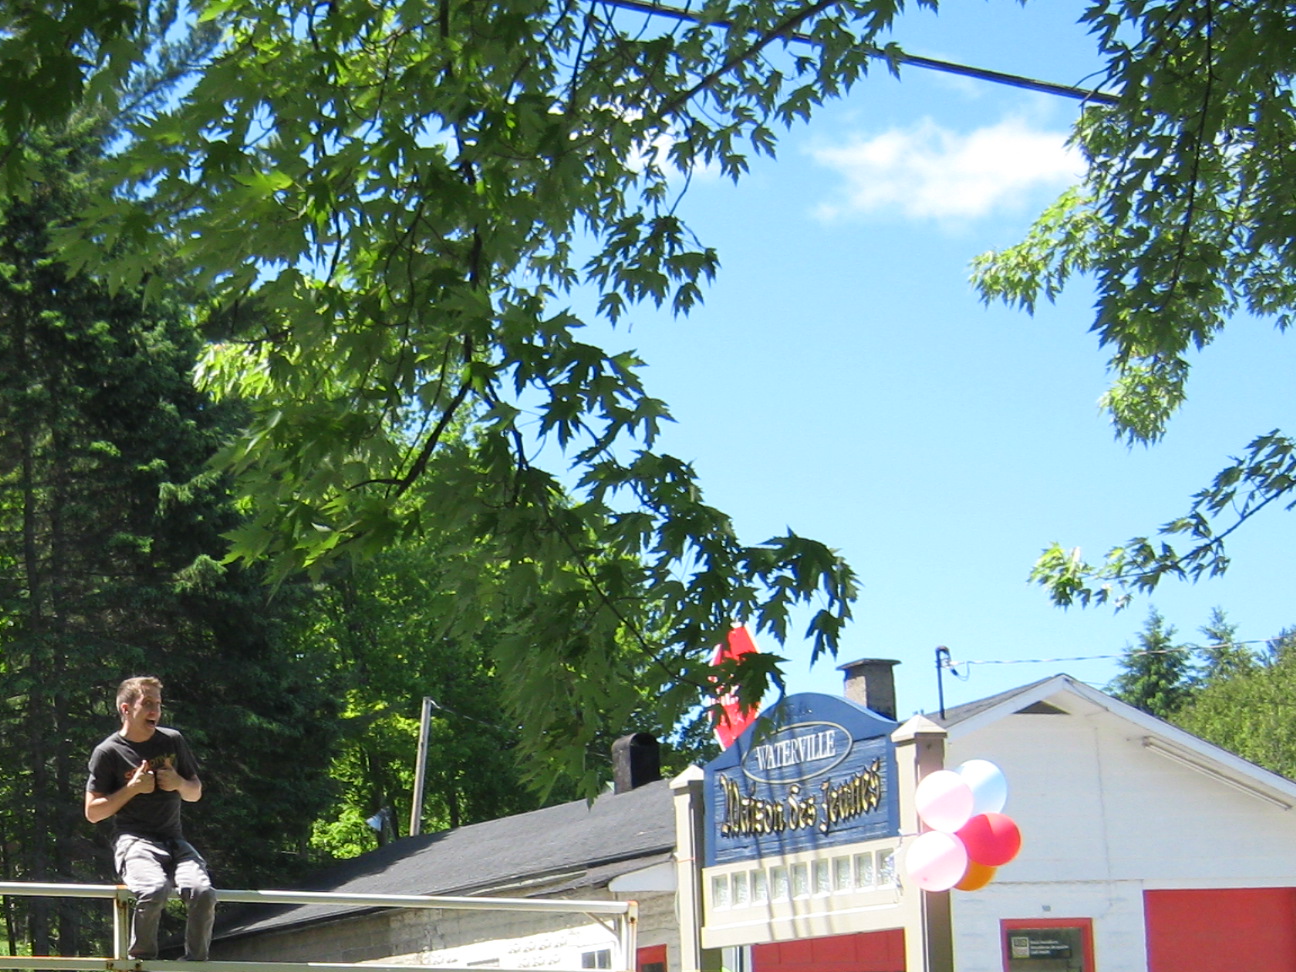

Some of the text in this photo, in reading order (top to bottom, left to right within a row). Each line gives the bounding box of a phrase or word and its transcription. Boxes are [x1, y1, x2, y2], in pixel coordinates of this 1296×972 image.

[756, 730, 836, 771] WATERVILLE
[719, 757, 881, 838] Maison des Jeunes
